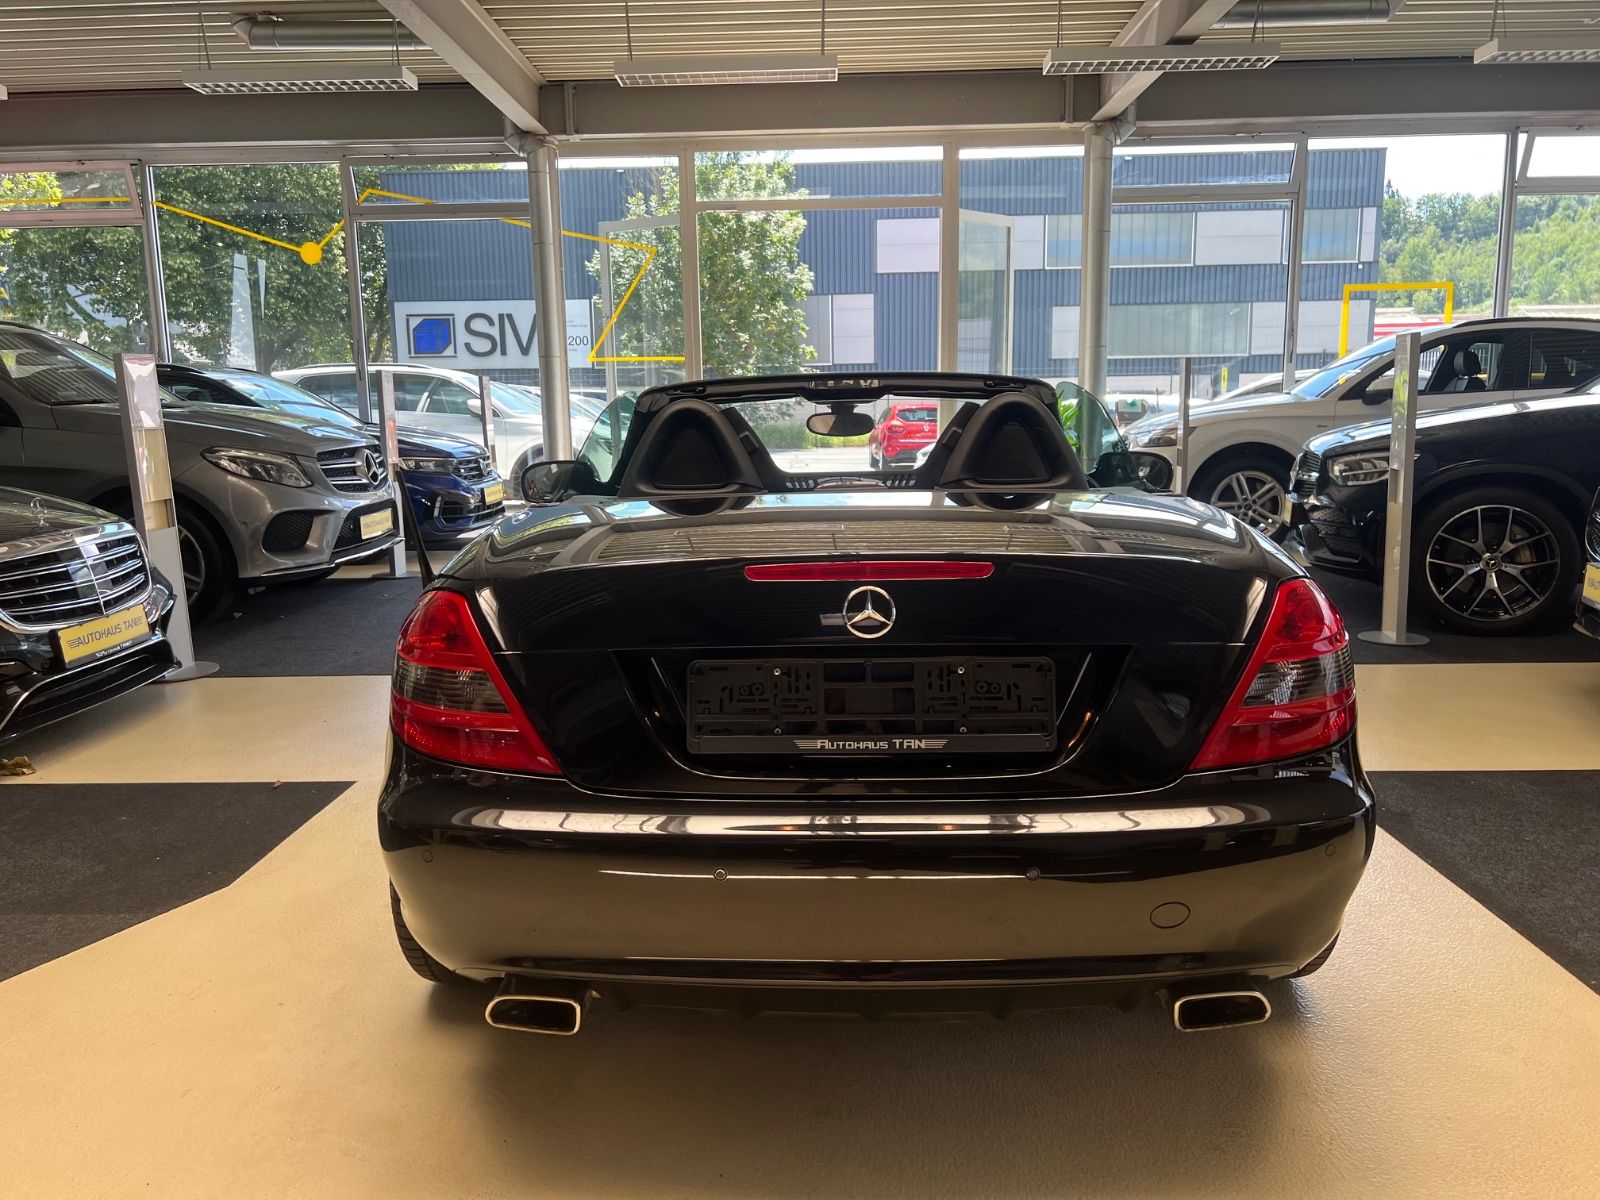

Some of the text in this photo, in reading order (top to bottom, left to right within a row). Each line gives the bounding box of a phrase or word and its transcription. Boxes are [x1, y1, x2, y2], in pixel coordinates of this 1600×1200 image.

[568, 335, 589, 346] 200
[77, 617, 139, 646] AUTOHAUS TAN
[892, 739, 926, 749] TAN
